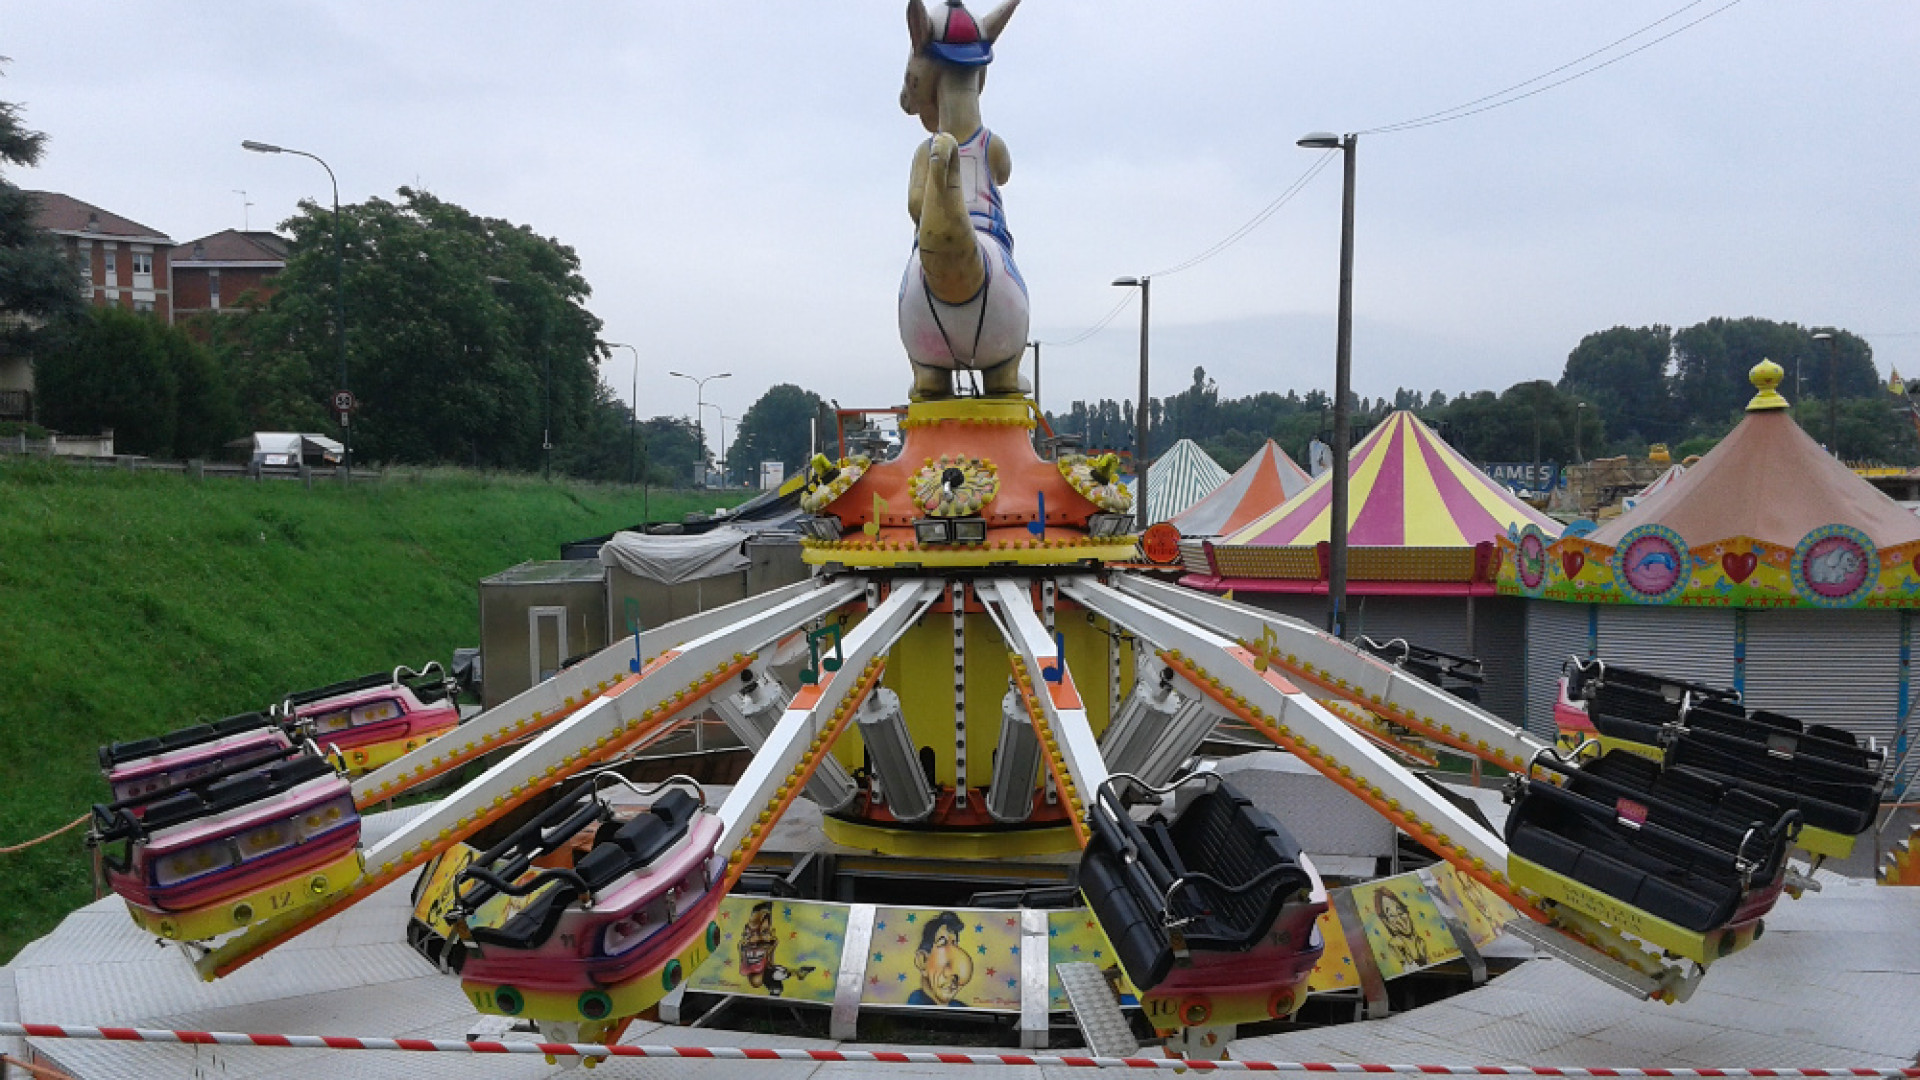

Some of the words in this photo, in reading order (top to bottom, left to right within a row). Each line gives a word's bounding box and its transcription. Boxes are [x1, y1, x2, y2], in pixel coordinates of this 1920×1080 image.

[269, 892, 294, 910] 12
[473, 991, 493, 1008] 11
[1150, 998, 1178, 1017] 10
